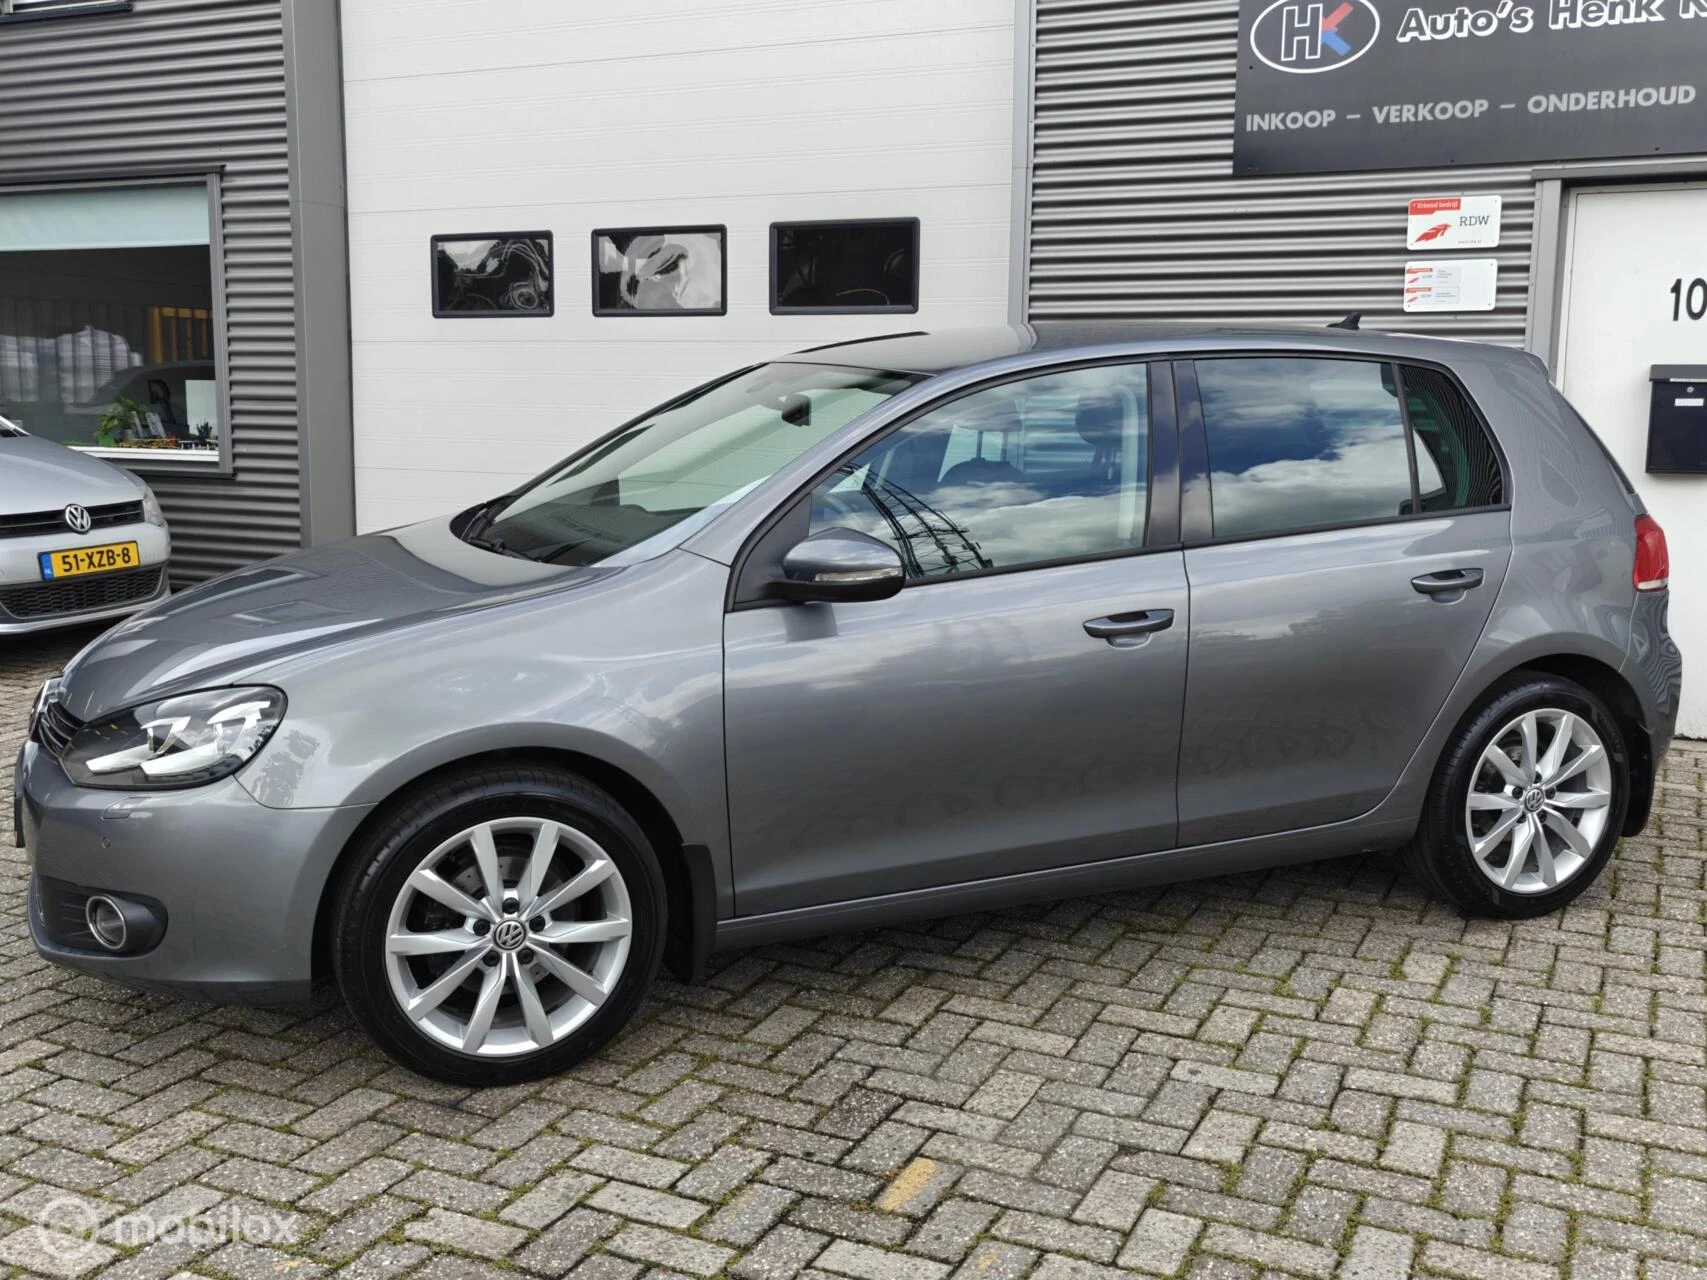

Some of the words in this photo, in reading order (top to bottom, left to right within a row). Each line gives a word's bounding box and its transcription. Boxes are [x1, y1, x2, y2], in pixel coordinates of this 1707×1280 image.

[1397, 0, 1534, 42] Auto's
[1549, 0, 1666, 29] Henk
[1246, 110, 1336, 132] INKOOP
[1373, 99, 1489, 124] VERKOOP
[1527, 85, 1696, 113] ONDERHOUD
[1459, 215, 1490, 226] RDW
[62, 547, 131, 572] 51-XZB-8
